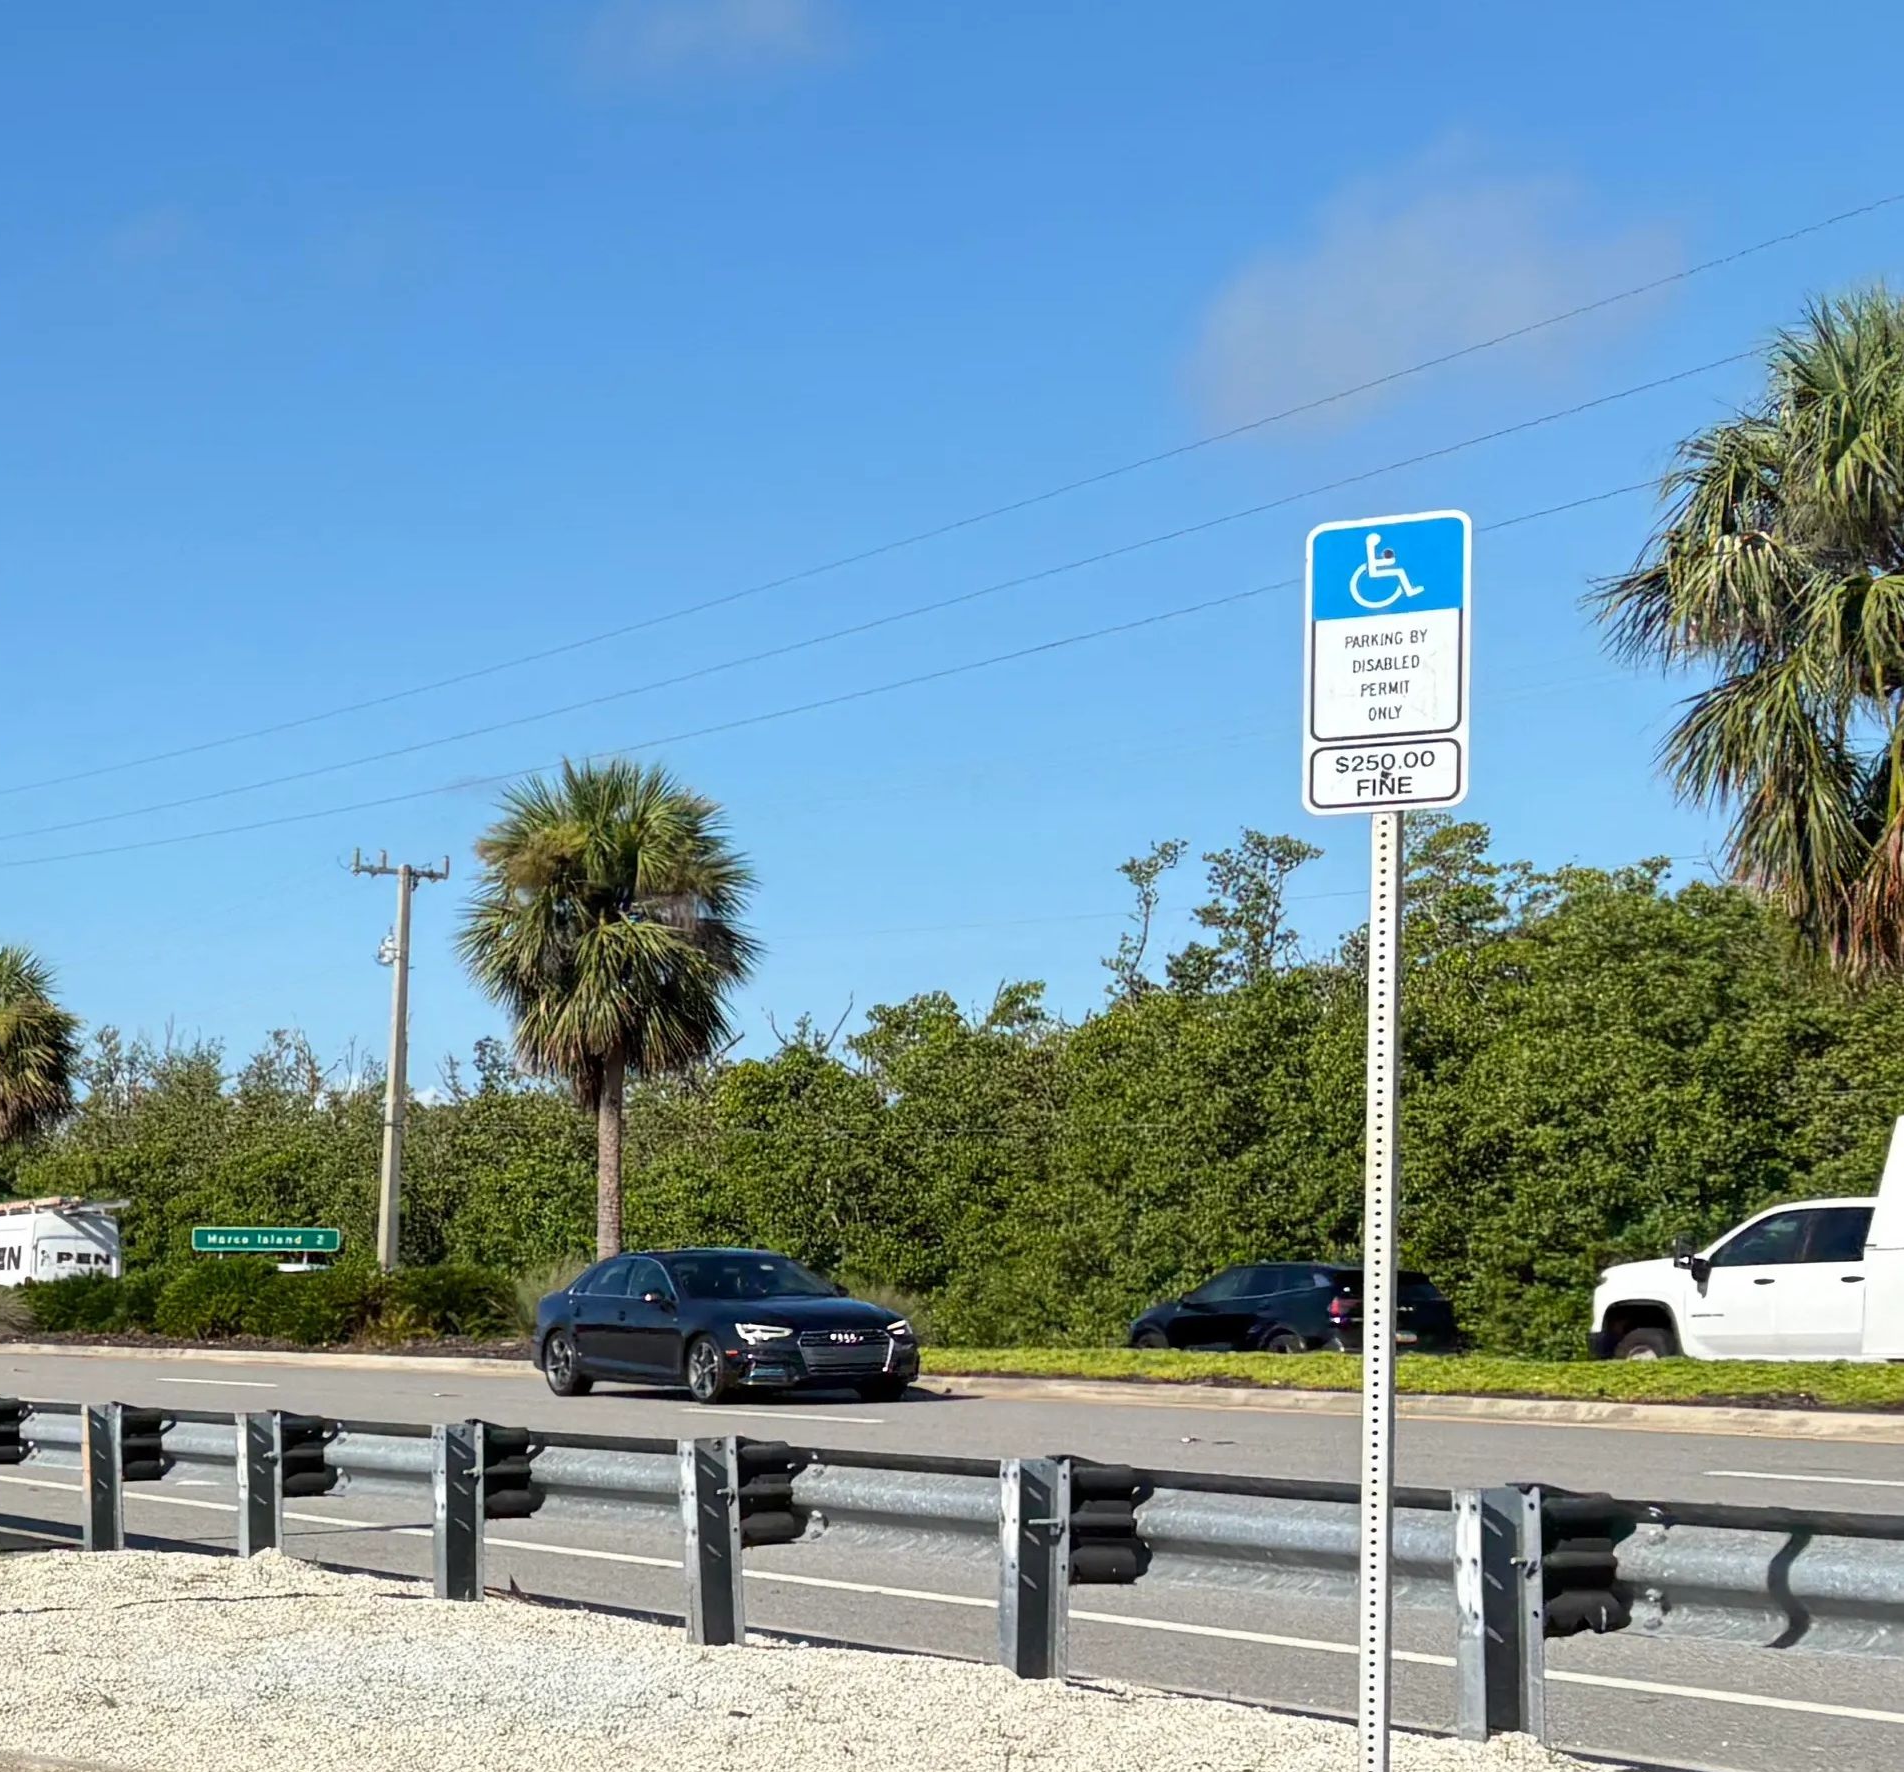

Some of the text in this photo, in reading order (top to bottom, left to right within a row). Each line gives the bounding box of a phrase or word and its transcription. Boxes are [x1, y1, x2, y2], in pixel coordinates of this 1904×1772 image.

[1344, 629, 1428, 649] PARKING BY
[1352, 654, 1421, 674] DISABLED
[1360, 679, 1411, 698] PERMIT
[1368, 704, 1403, 722] ONLY
[1335, 749, 1436, 774] $250.00
[1356, 775, 1413, 798] FINE
[207, 1233, 249, 1245] Marco
[257, 1233, 302, 1245] Island
